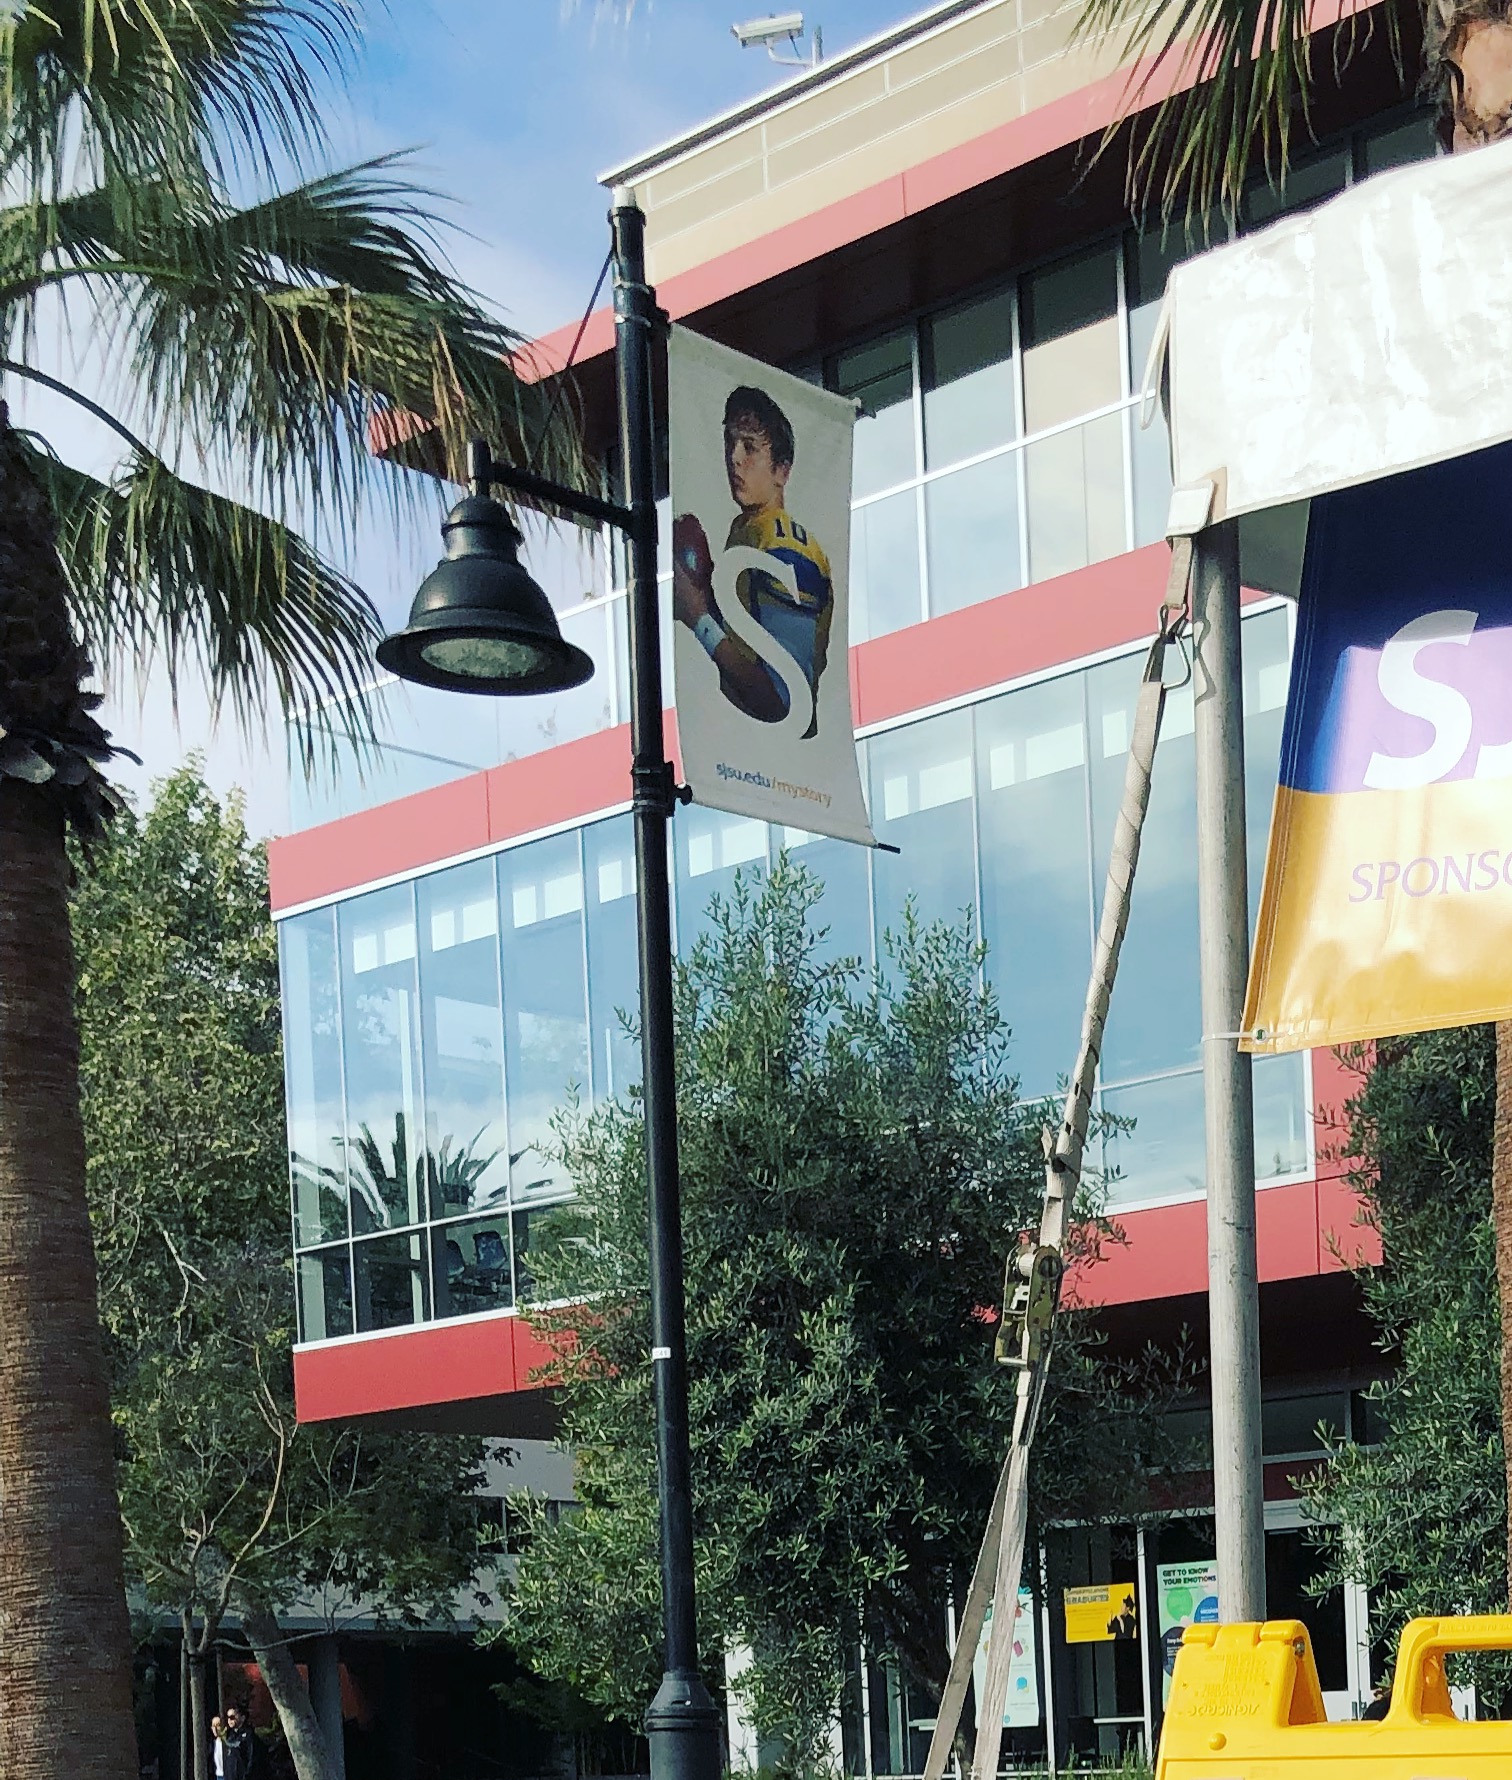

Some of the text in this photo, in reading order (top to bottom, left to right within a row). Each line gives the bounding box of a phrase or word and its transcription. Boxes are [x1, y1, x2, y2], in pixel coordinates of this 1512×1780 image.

[716, 762, 832, 806] sjsu.edu/mystory
[1177, 1568, 1187, 1576] TO
[1163, 1574, 1217, 1586] YOUR EMOTIONS
